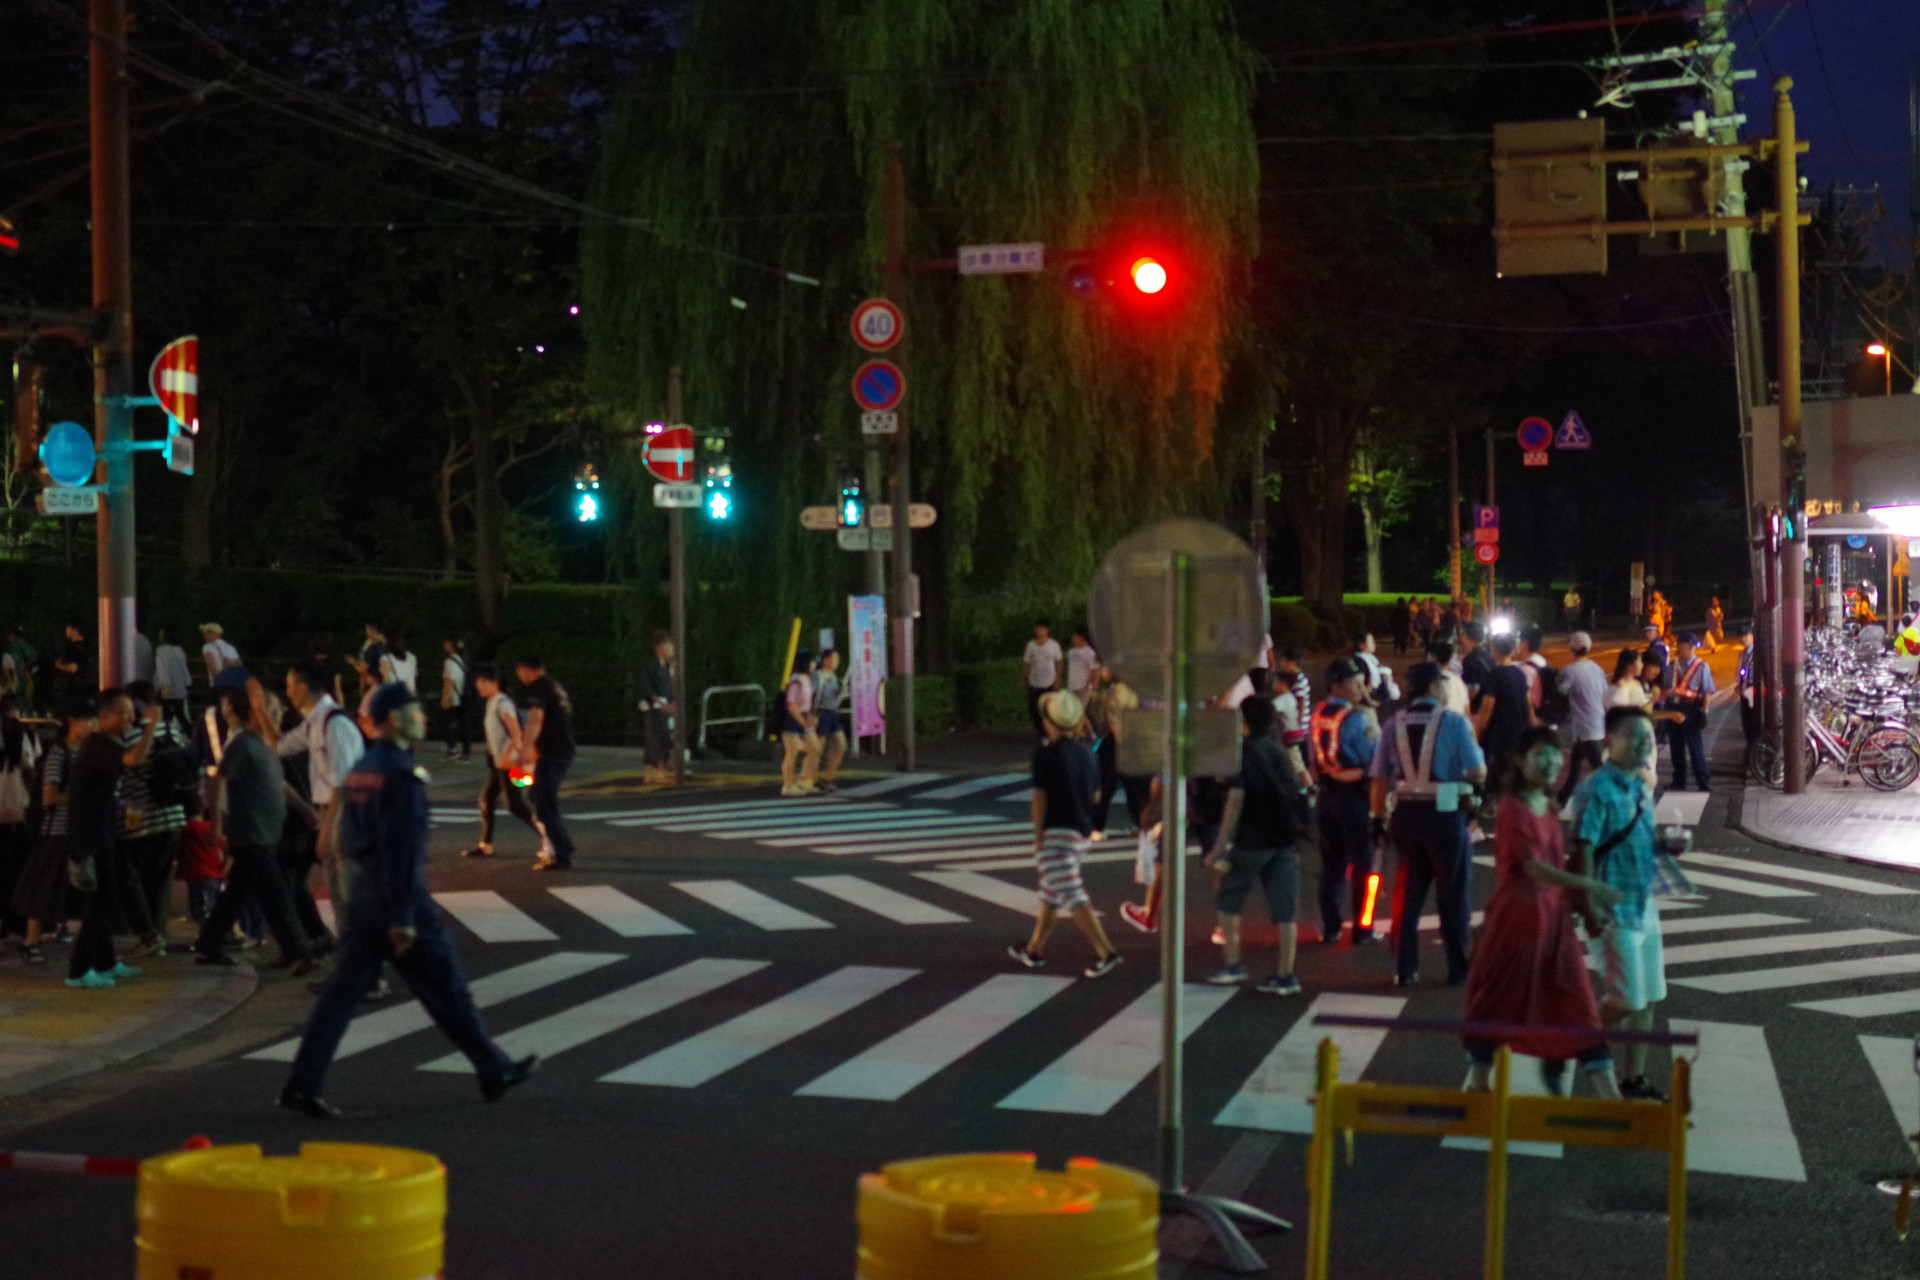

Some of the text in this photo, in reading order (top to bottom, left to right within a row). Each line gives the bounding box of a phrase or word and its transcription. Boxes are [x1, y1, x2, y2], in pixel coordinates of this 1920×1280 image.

[865, 313, 893, 336] 40
[46, 492, 95, 508] ここから
[1480, 508, 1495, 528] P
